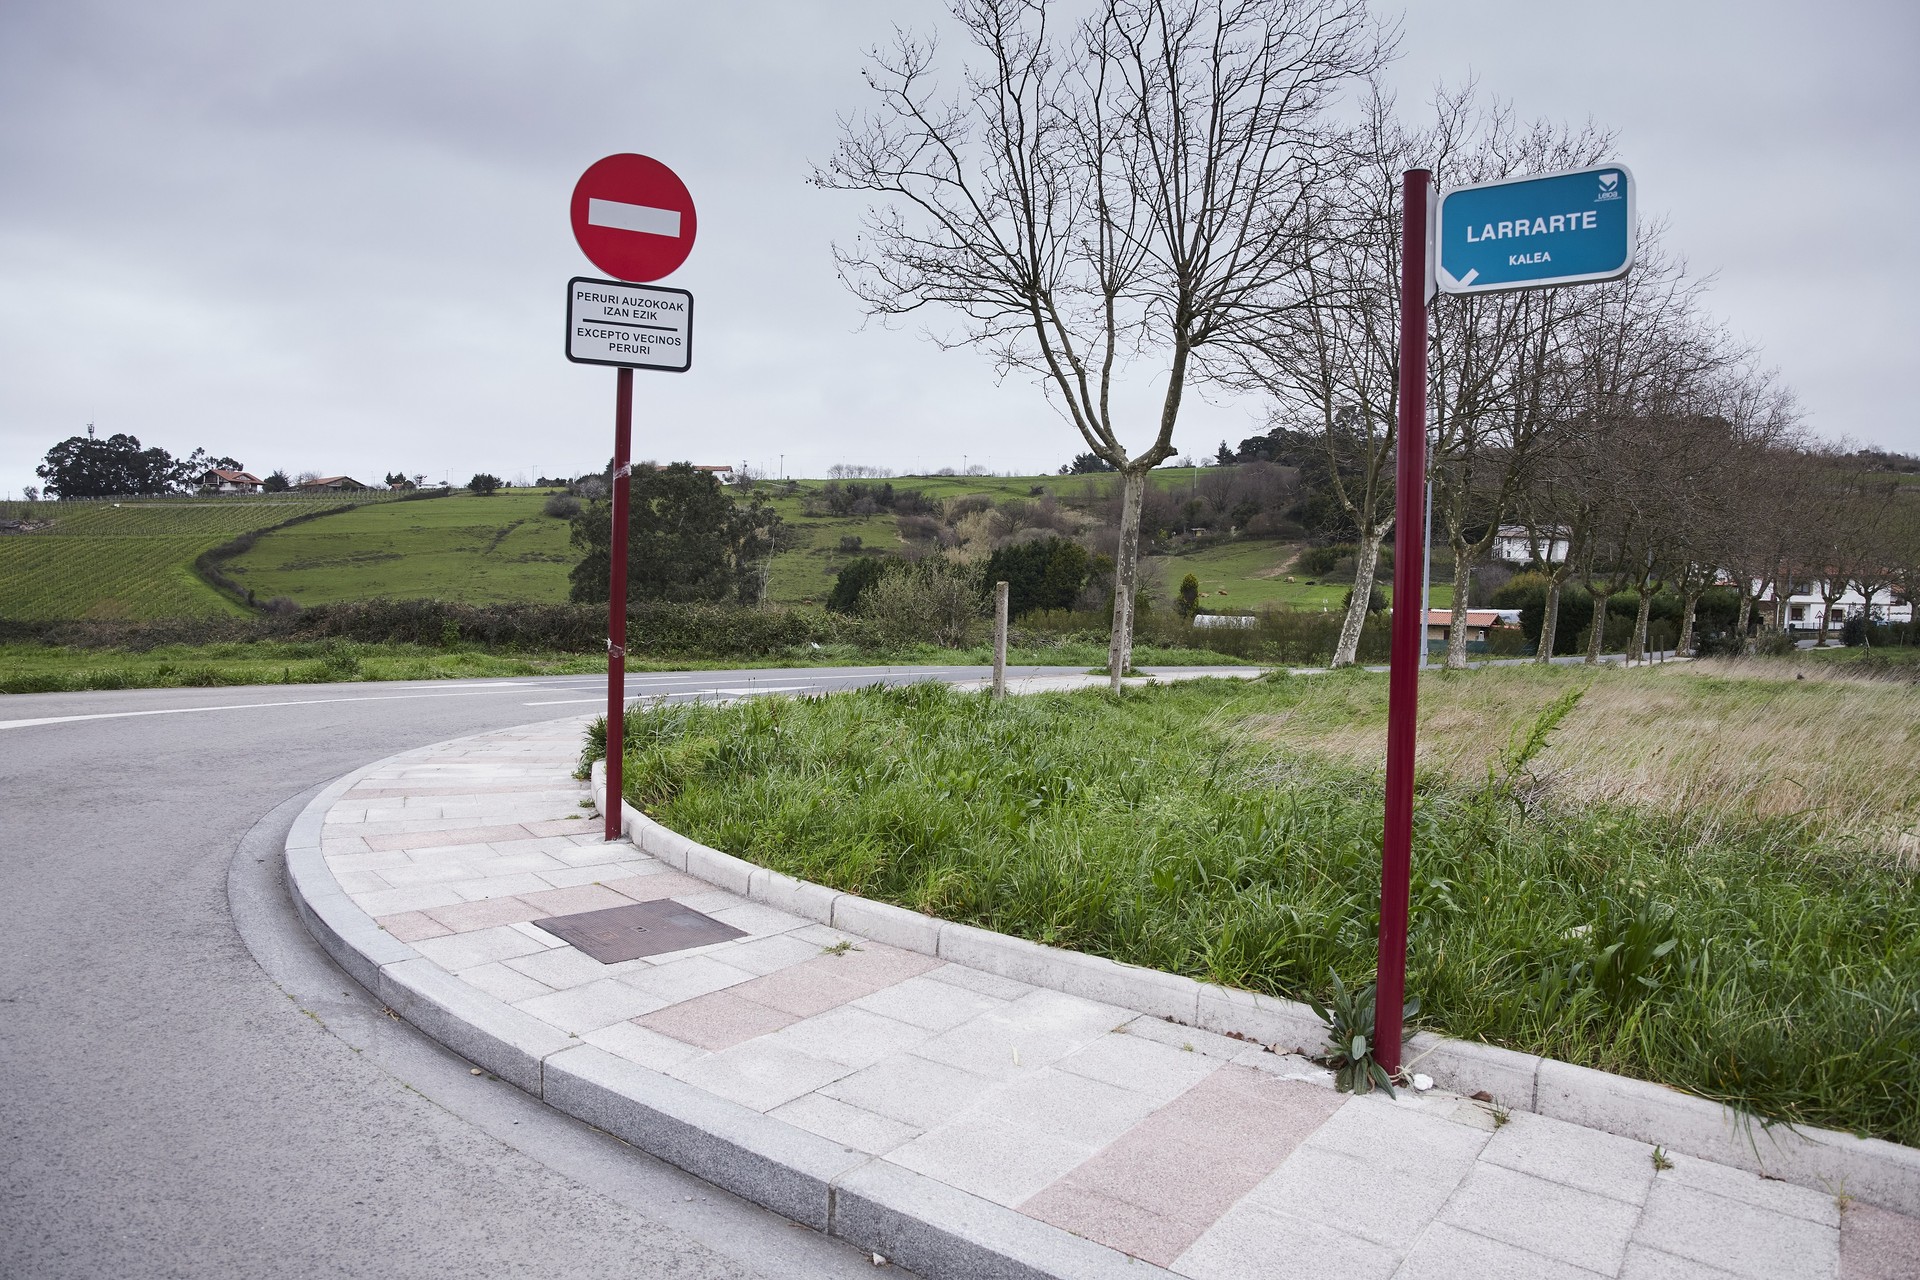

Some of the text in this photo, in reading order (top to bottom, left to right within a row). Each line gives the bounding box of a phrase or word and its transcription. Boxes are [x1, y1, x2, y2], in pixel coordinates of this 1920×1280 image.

[1467, 211, 1597, 243] LARRARTE
[1509, 252, 1551, 266] KALEA
[577, 291, 684, 312] PERURI AUZOKOAK
[603, 306, 658, 321] IZAN EZIK
[577, 327, 682, 346] EXCEPTO VECINOS
[609, 343, 650, 355] PERURI
